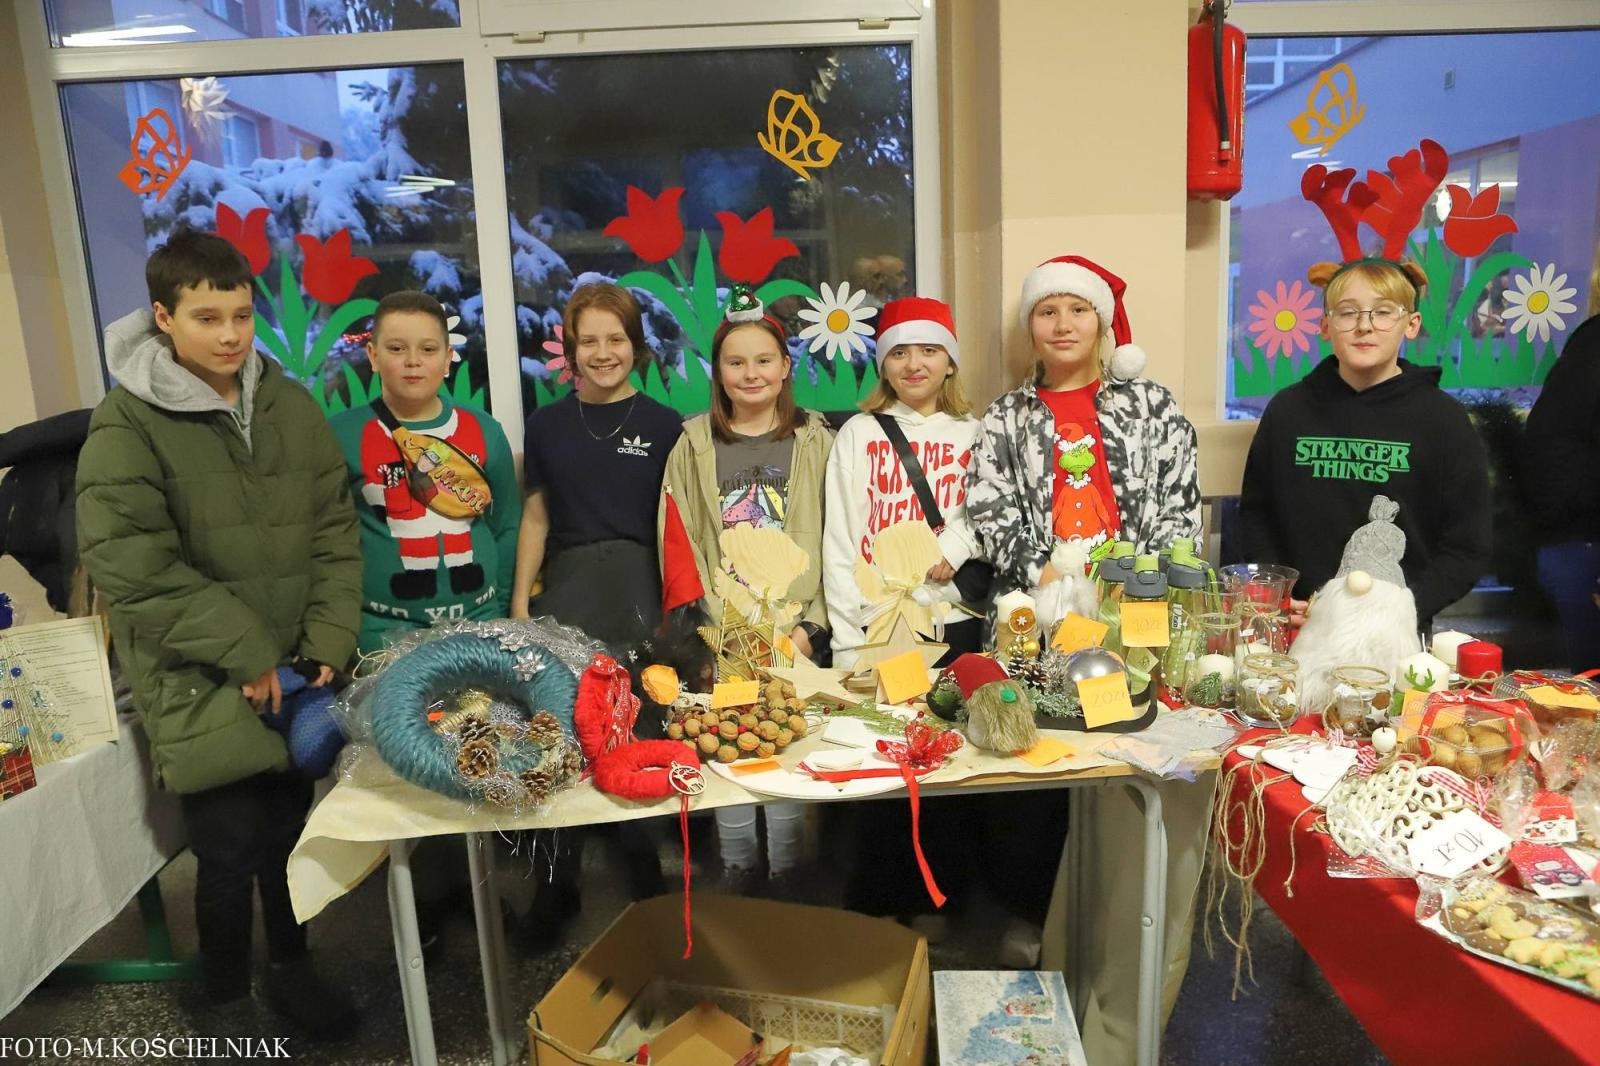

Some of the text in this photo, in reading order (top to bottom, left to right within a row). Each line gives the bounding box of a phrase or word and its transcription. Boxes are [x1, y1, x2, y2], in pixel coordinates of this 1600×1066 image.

[617, 446, 649, 457] adidas
[923, 441, 954, 476] ME
[1295, 438, 1410, 469] STRANGER
[1311, 459, 1390, 482] THINGS
